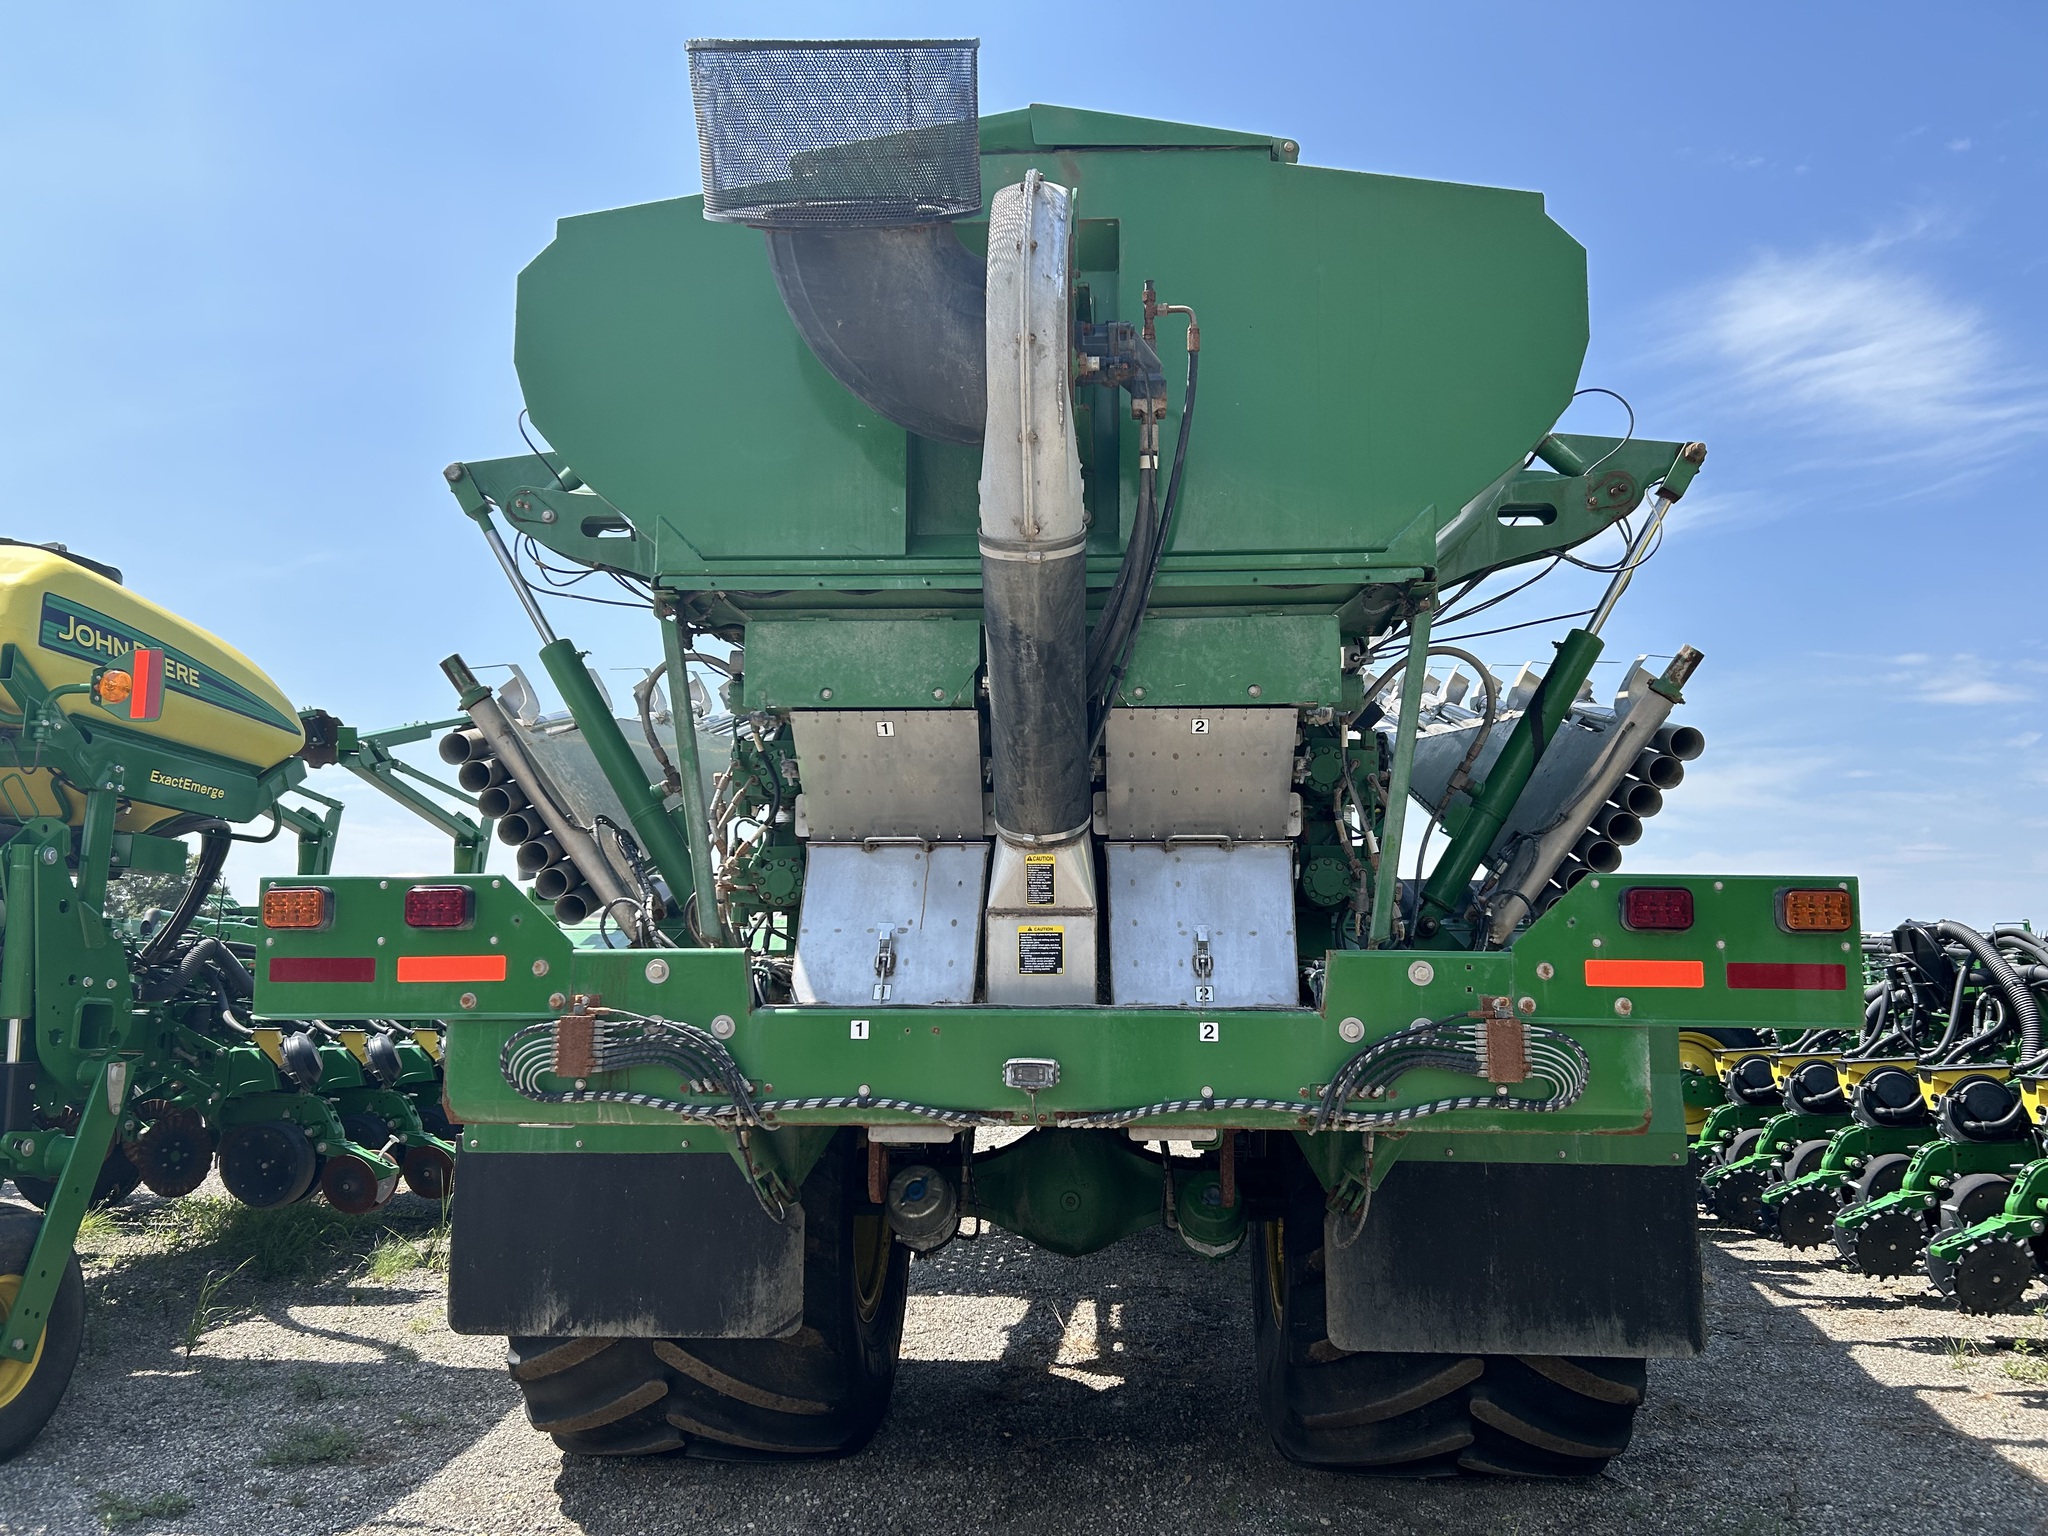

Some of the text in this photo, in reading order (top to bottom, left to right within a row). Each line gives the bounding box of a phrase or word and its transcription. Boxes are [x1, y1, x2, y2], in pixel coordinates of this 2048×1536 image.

[58, 615, 200, 689] JOHN ERE
[881, 722, 888, 735] 1
[1195, 720, 1205, 732] 2
[150, 769, 225, 799] ExactEmerge
[1199, 987, 1210, 1000] 2
[855, 1022, 863, 1037] 1
[1203, 1024, 1215, 1040] 2
